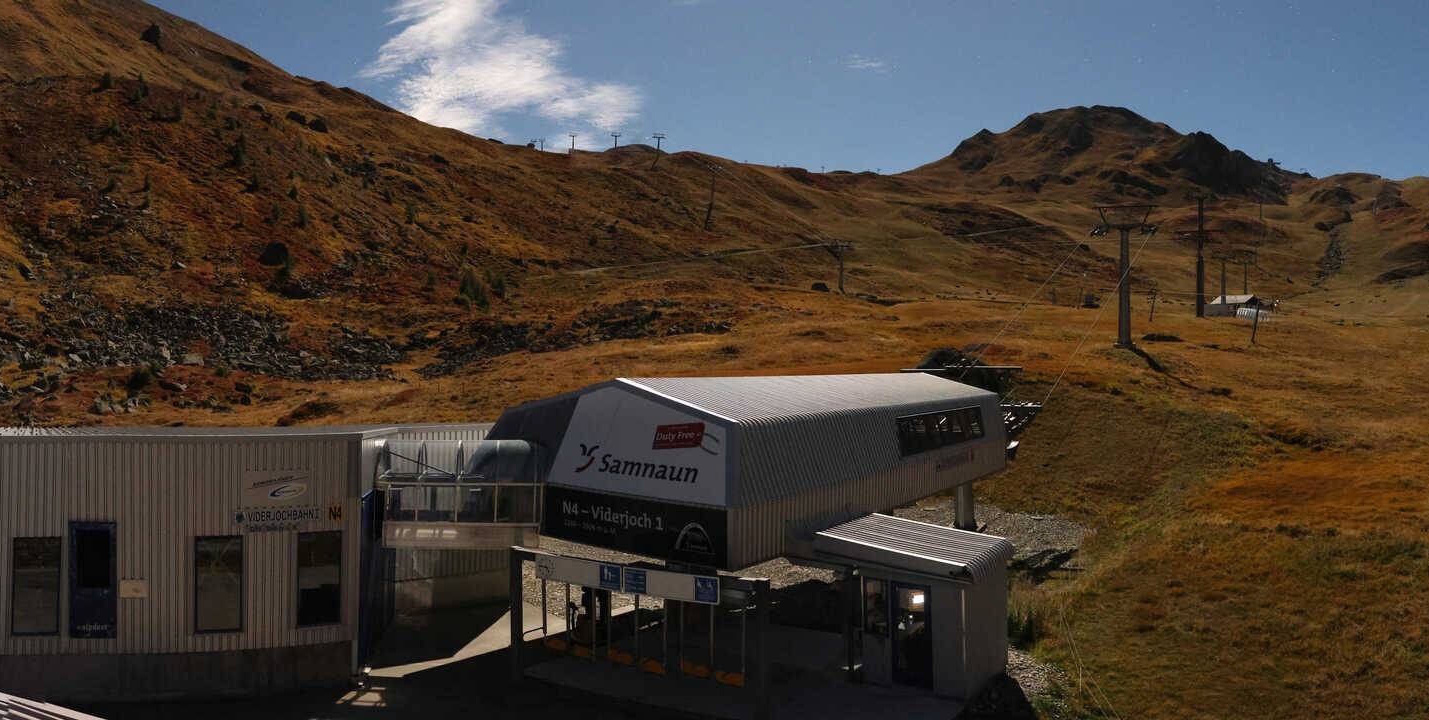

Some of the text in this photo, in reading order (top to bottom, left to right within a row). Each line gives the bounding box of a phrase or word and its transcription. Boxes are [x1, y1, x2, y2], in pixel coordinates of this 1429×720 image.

[656, 431, 695, 442] Duty Free
[598, 453, 699, 484] Samnaun
[248, 509, 315, 522] VIDERJOCHBAHN
[329, 506, 342, 521] N4
[562, 500, 578, 516] N4
[591, 505, 652, 529] Viderjoch
[655, 516, 664, 531] 1
